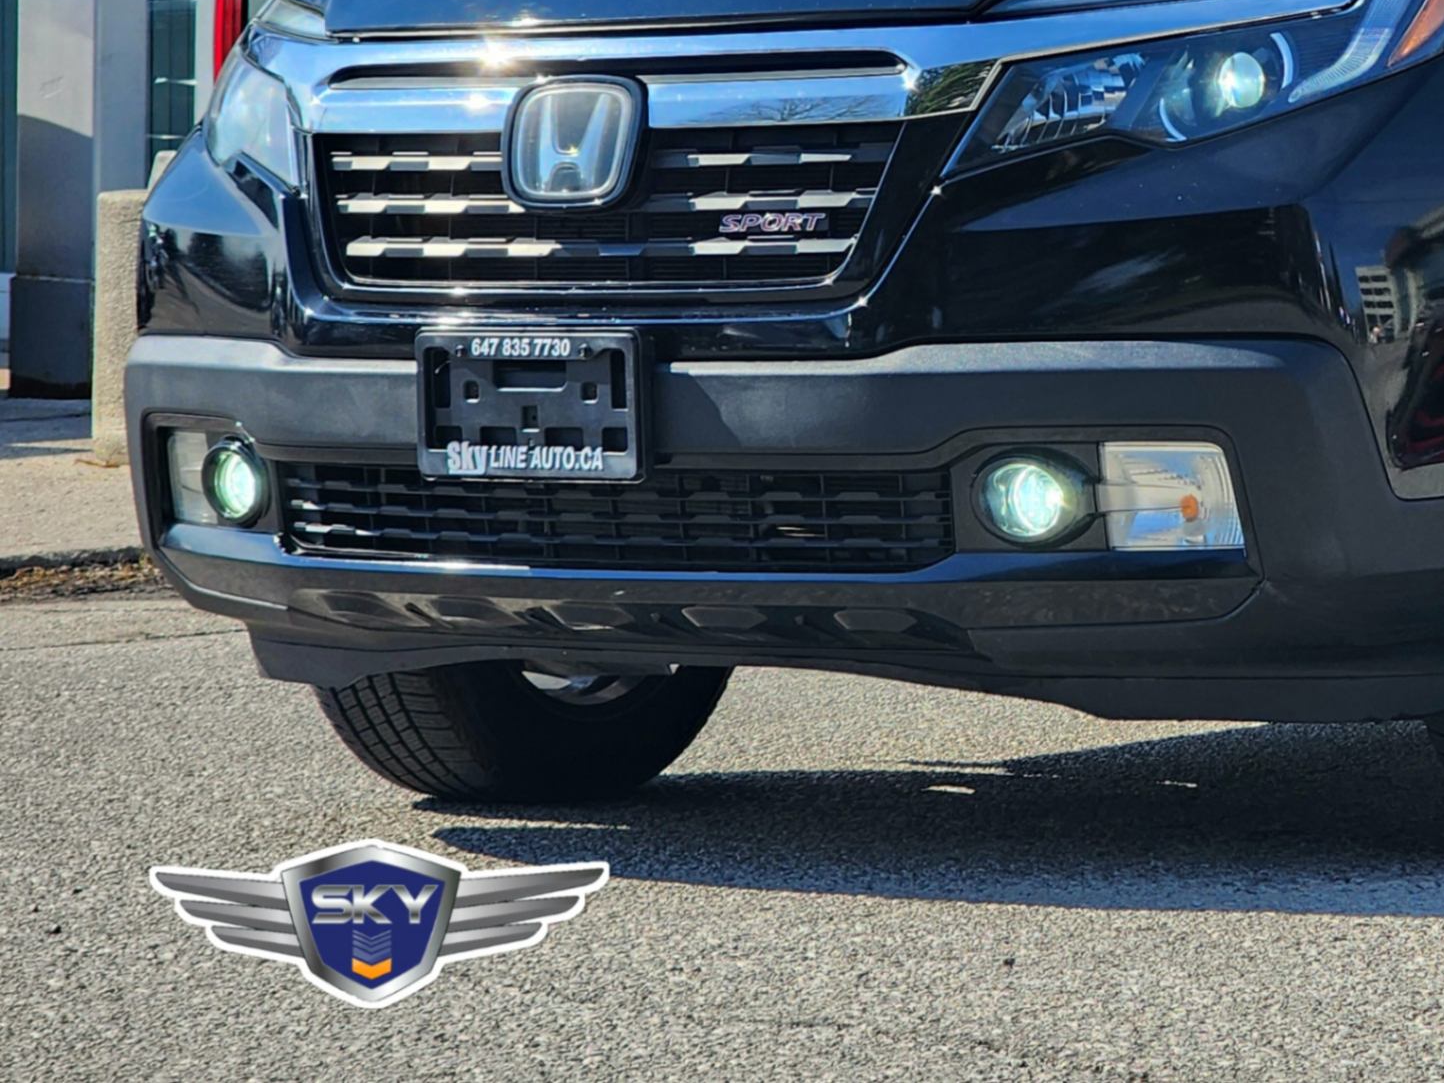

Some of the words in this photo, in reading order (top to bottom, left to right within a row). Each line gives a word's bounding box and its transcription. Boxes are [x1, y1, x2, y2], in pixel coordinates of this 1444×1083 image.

[719, 212, 826, 232] SPORT
[471, 338, 499, 356] 647
[502, 338, 530, 356] 835
[534, 338, 571, 357] 7730
[530, 446, 603, 470] AUTO.CA
